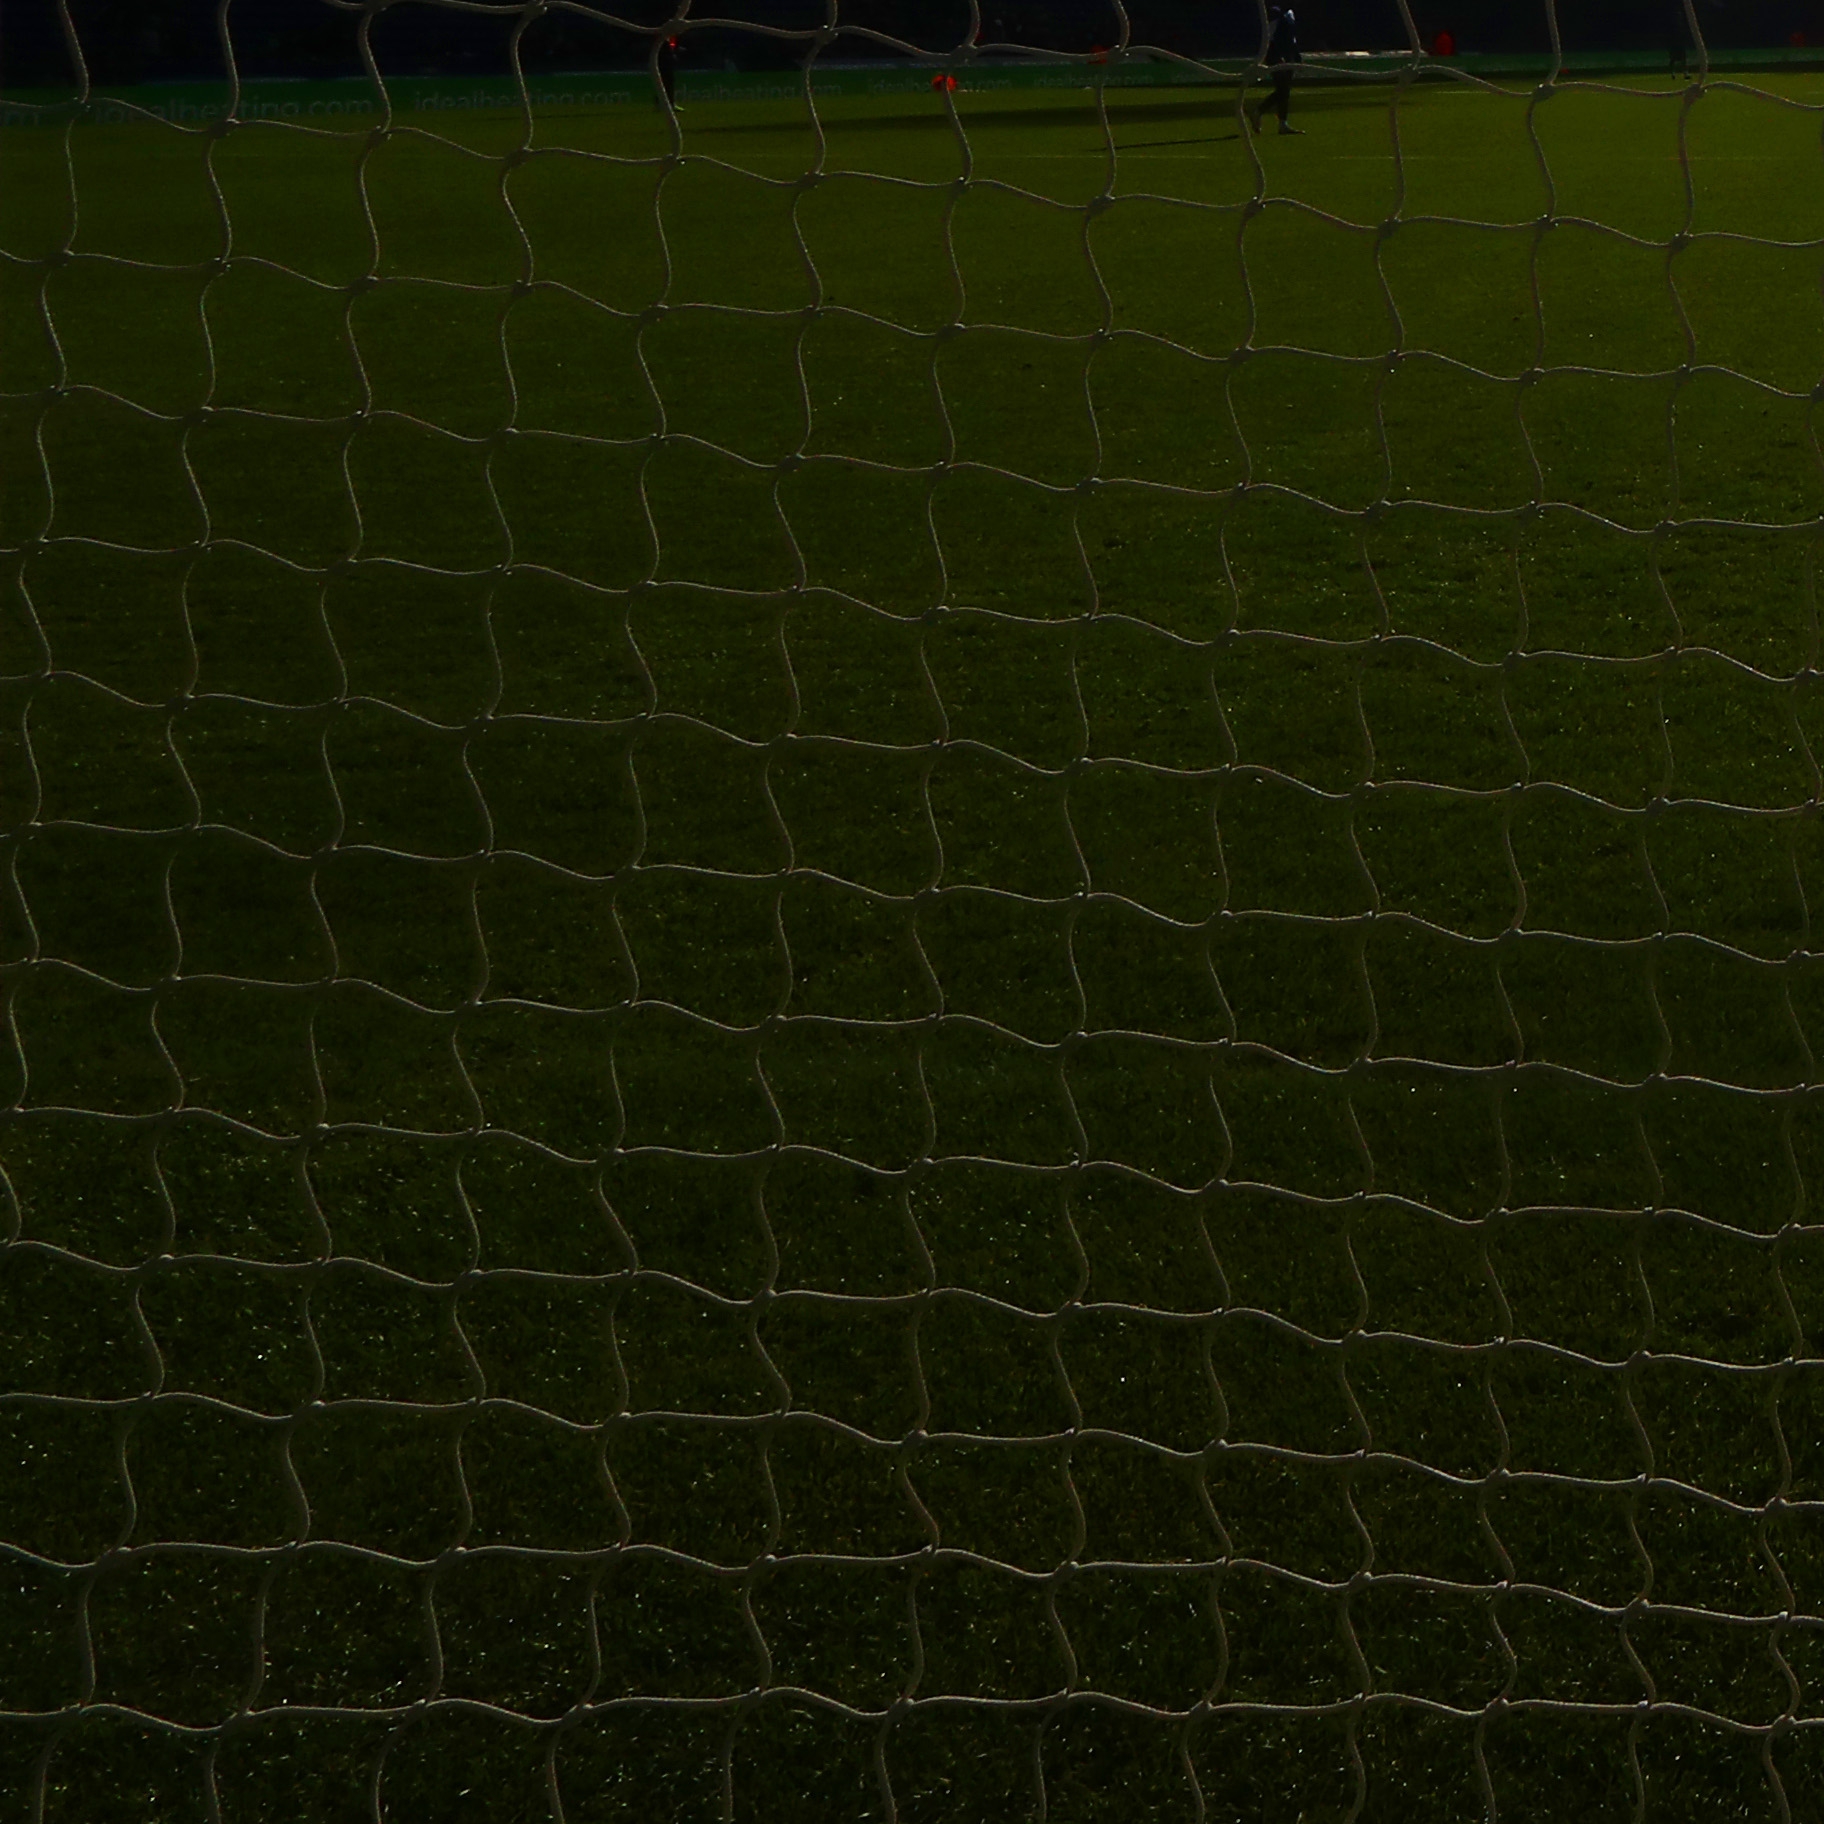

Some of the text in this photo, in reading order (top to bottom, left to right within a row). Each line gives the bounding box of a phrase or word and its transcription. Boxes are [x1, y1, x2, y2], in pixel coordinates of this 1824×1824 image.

[413, 88, 631, 114] idealheaing.com
[672, 82, 843, 103] dealheating.om
[94, 93, 374, 126] idalheting.com
